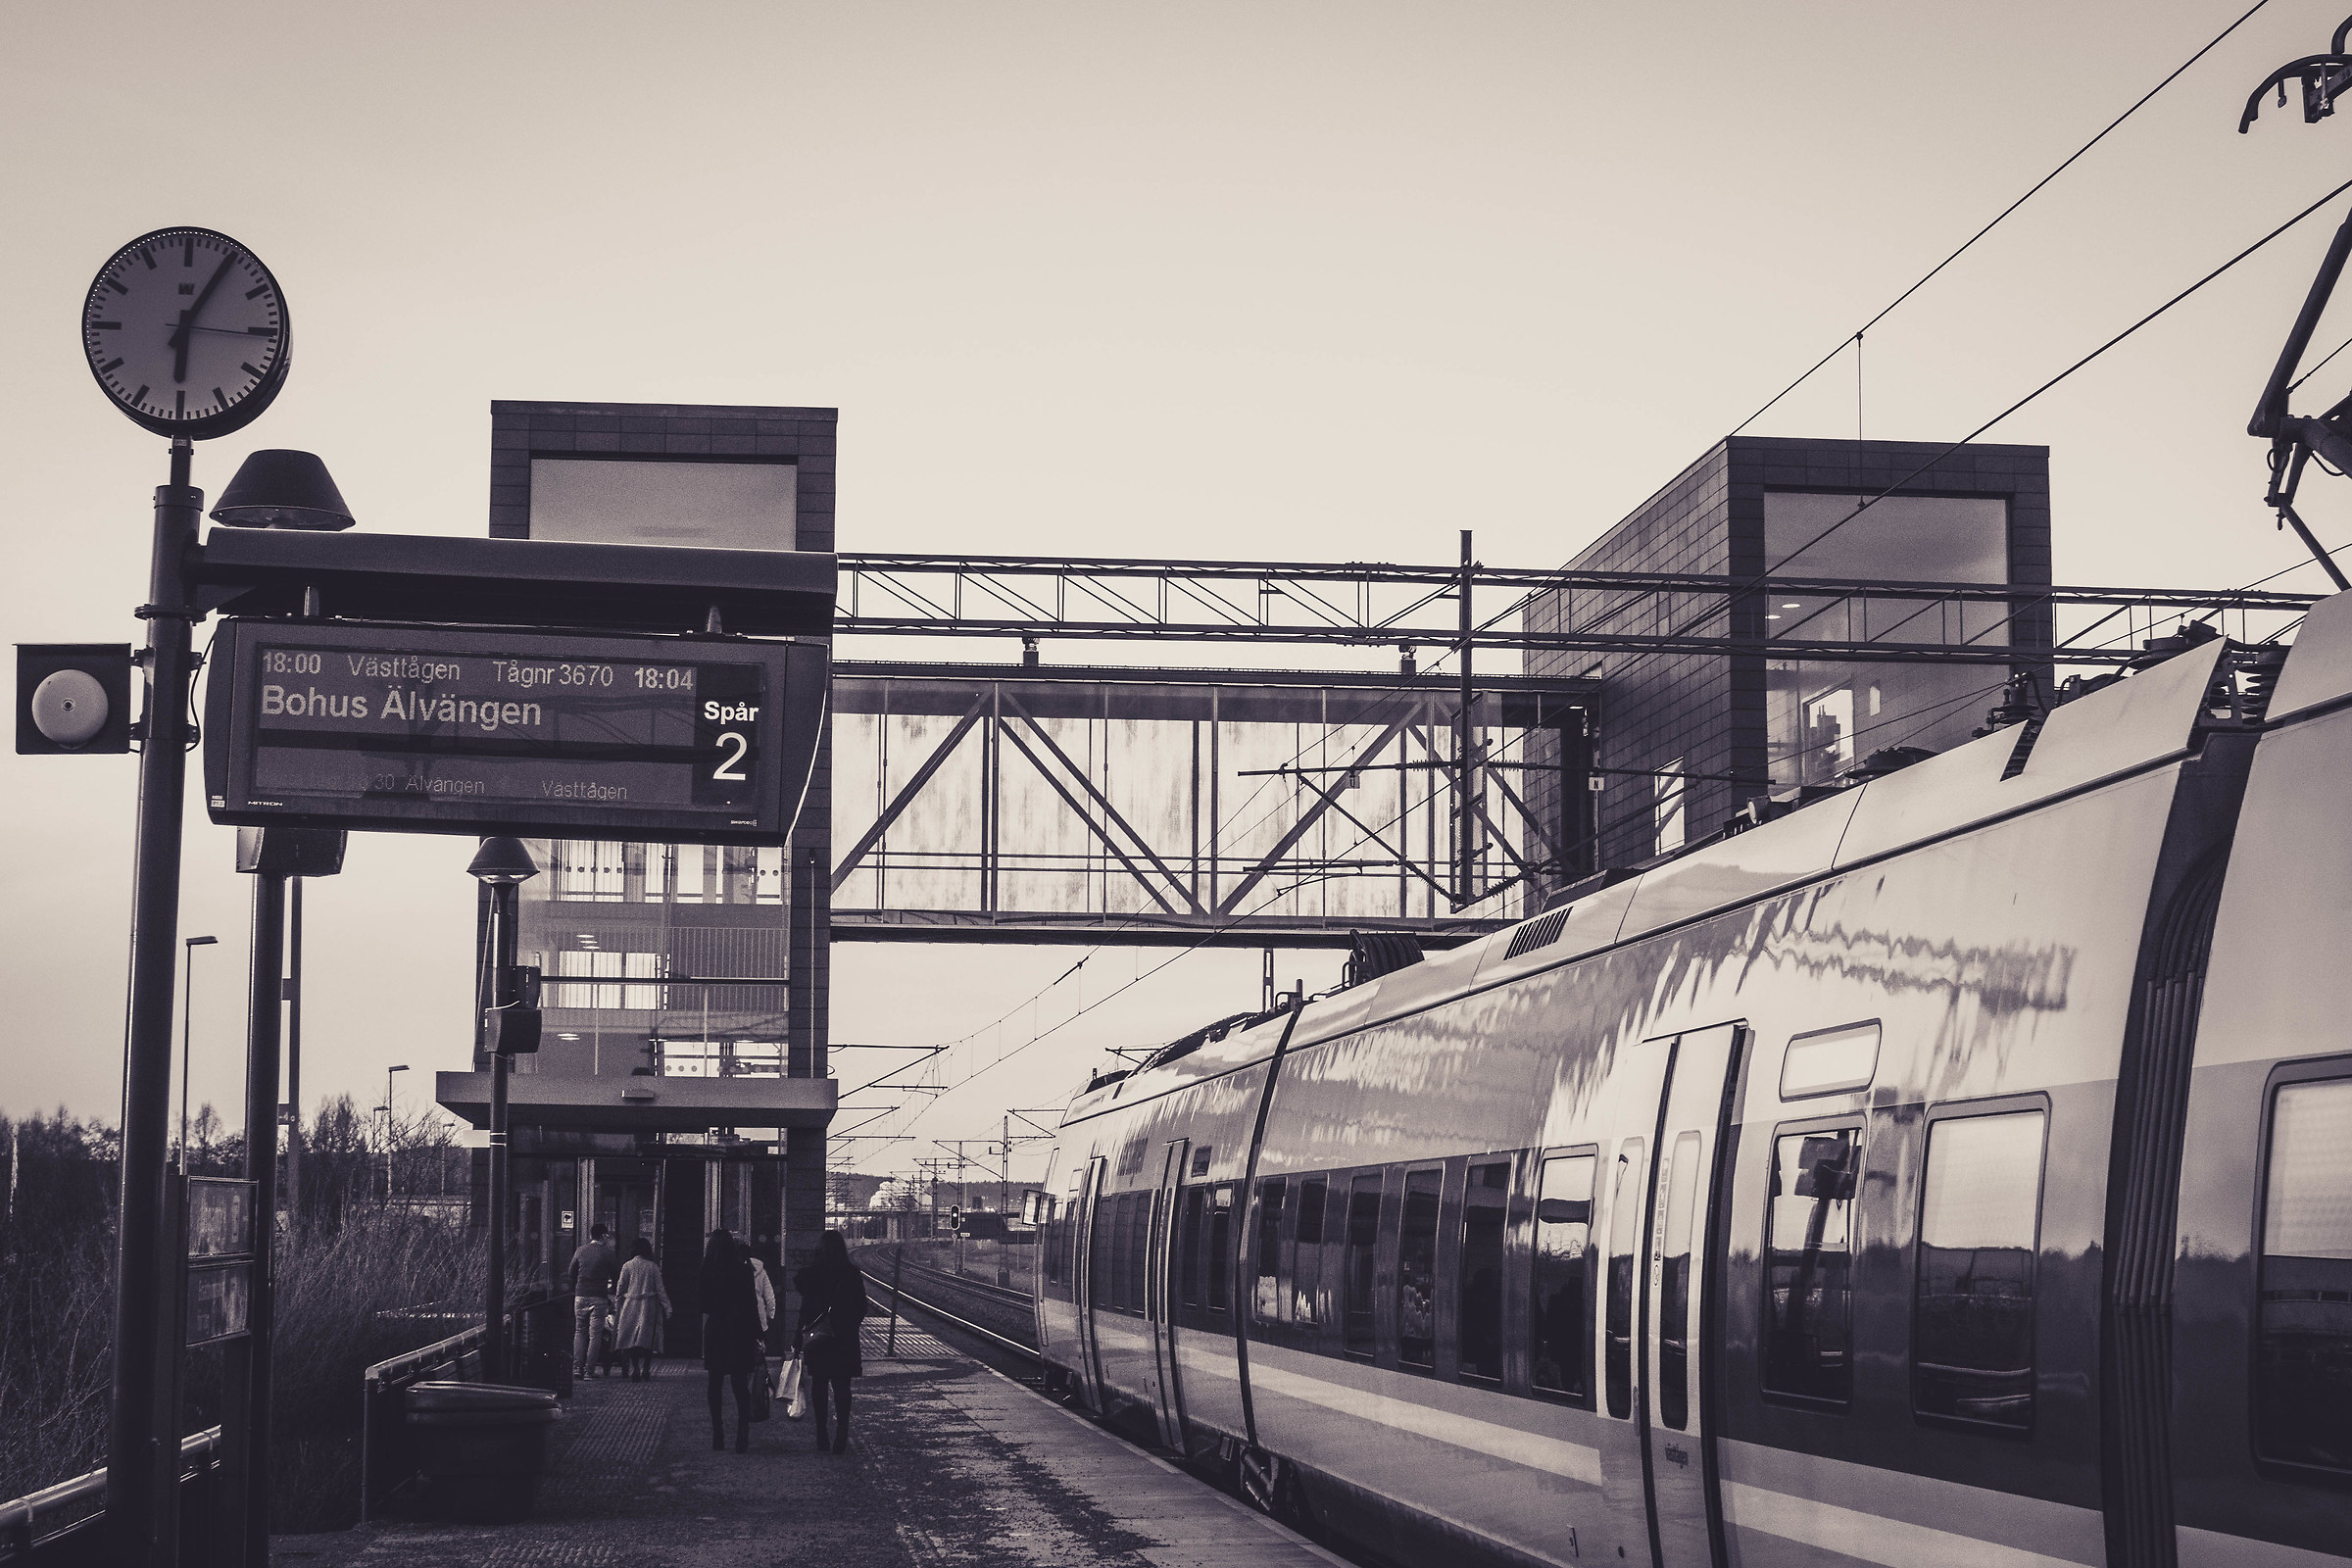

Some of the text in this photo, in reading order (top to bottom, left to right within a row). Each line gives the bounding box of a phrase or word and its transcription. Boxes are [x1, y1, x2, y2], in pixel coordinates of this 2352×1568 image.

[263, 652, 694, 690] 18:00 Västtågen Tågnr 3670 18:04
[262, 685, 541, 731] Bohus Älvängen
[704, 701, 760, 724] Spår
[712, 732, 748, 781] 2
[542, 780, 628, 801] Västtågen
